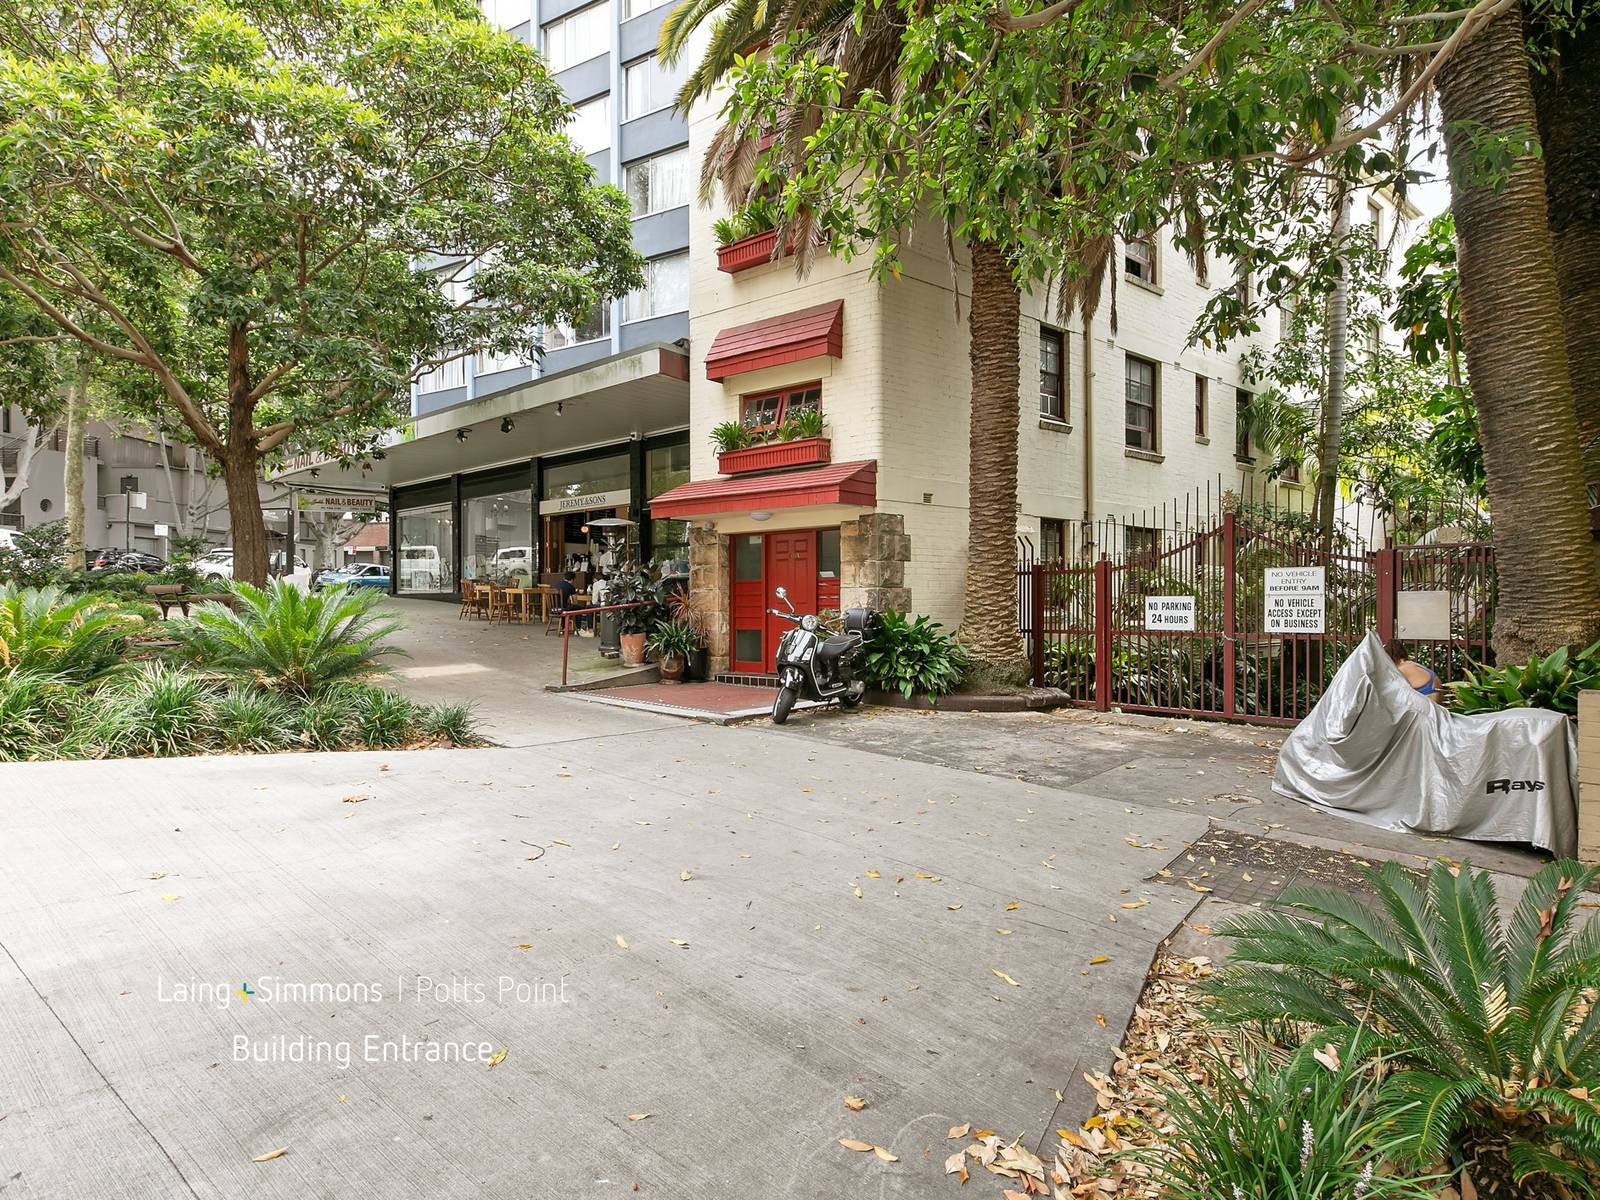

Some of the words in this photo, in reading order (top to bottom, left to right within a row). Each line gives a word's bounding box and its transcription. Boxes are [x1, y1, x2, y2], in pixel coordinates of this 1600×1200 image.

[293, 454, 313, 470] NAIL
[1148, 602, 1158, 611] NO
[1161, 602, 1192, 611] PARKING
[1274, 598, 1284, 607] NO
[1287, 598, 1315, 607] VEHICLE
[1267, 609, 1293, 618] ACCESS
[1296, 609, 1321, 618] EXCEPT
[1151, 613, 1163, 623] 24
[1164, 615, 1189, 624] HOURS
[1270, 619, 1280, 628] ON
[1284, 619, 1319, 628] BUSINESS
[1486, 779, 1545, 795] Rays
